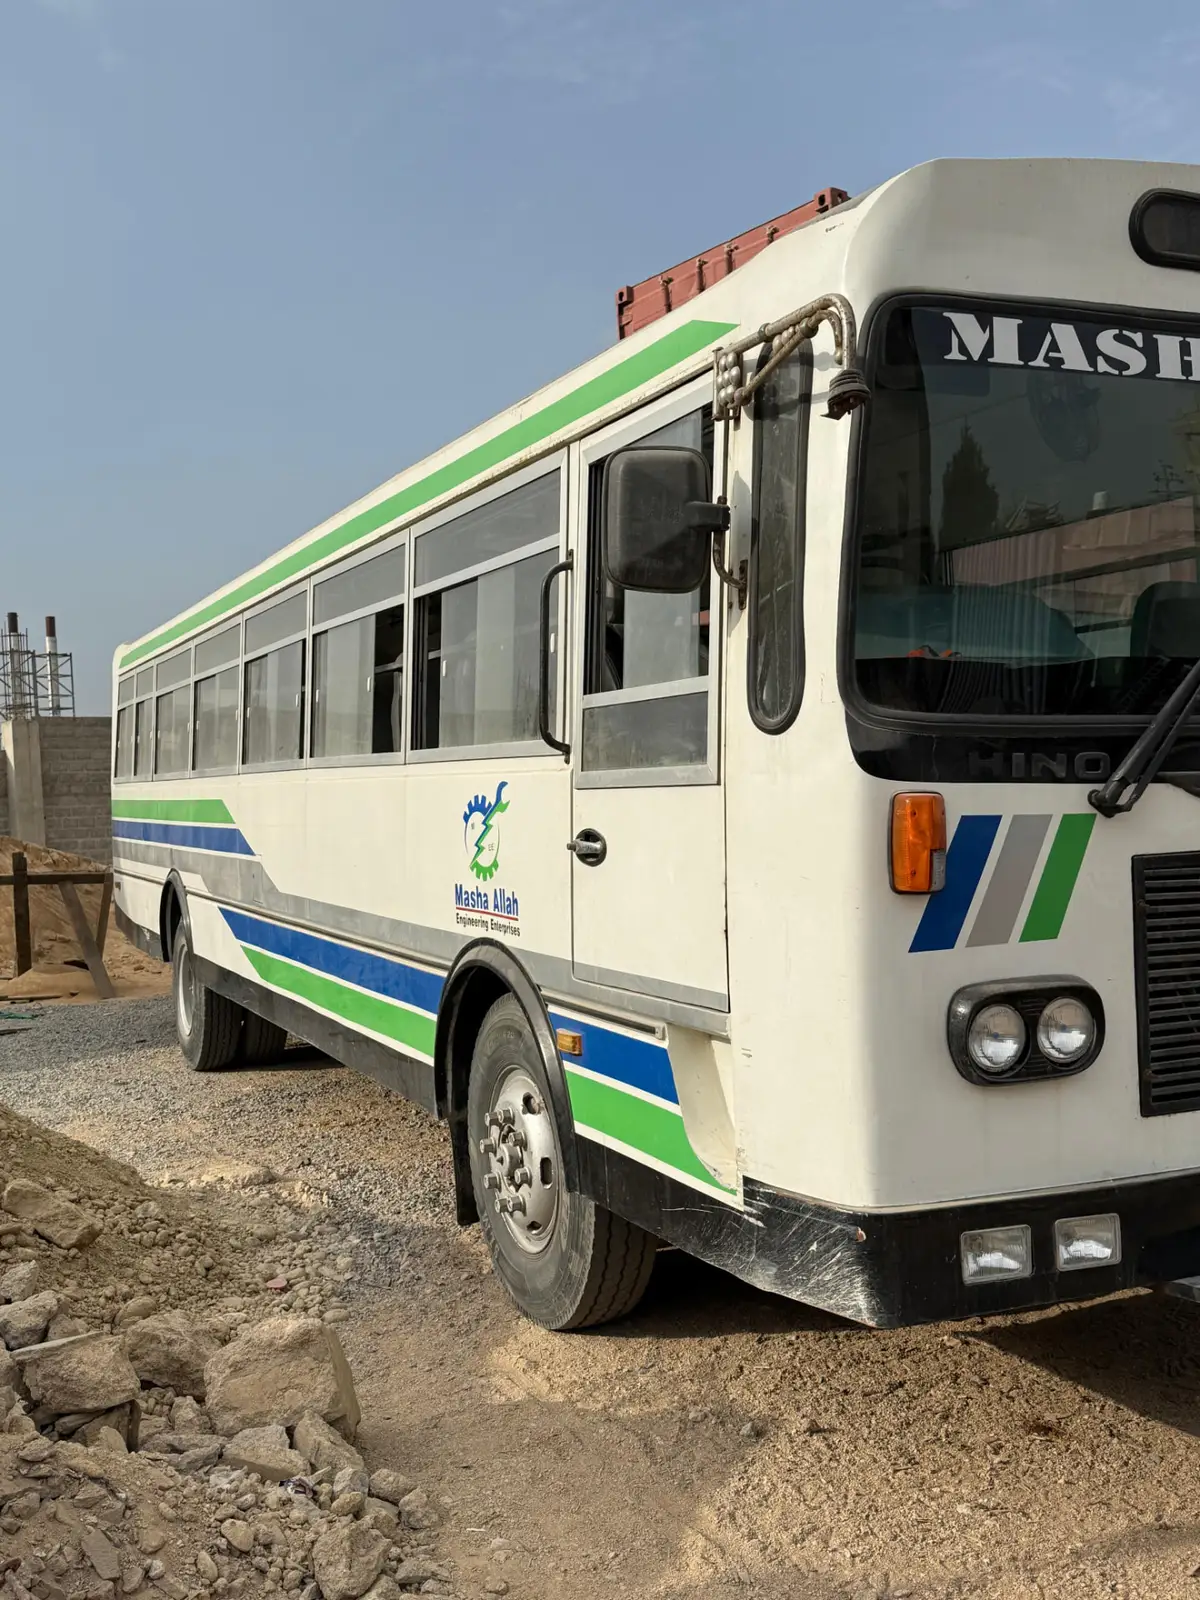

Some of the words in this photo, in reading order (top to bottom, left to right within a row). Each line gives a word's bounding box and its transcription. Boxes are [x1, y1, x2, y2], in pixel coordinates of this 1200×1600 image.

[943, 312, 1200, 381] MASH
[968, 752, 1111, 780] HINO
[455, 883, 489, 910] Masha
[493, 888, 519, 916] Allah
[456, 912, 489, 932] Engineering
[490, 918, 521, 937] Enterprises
